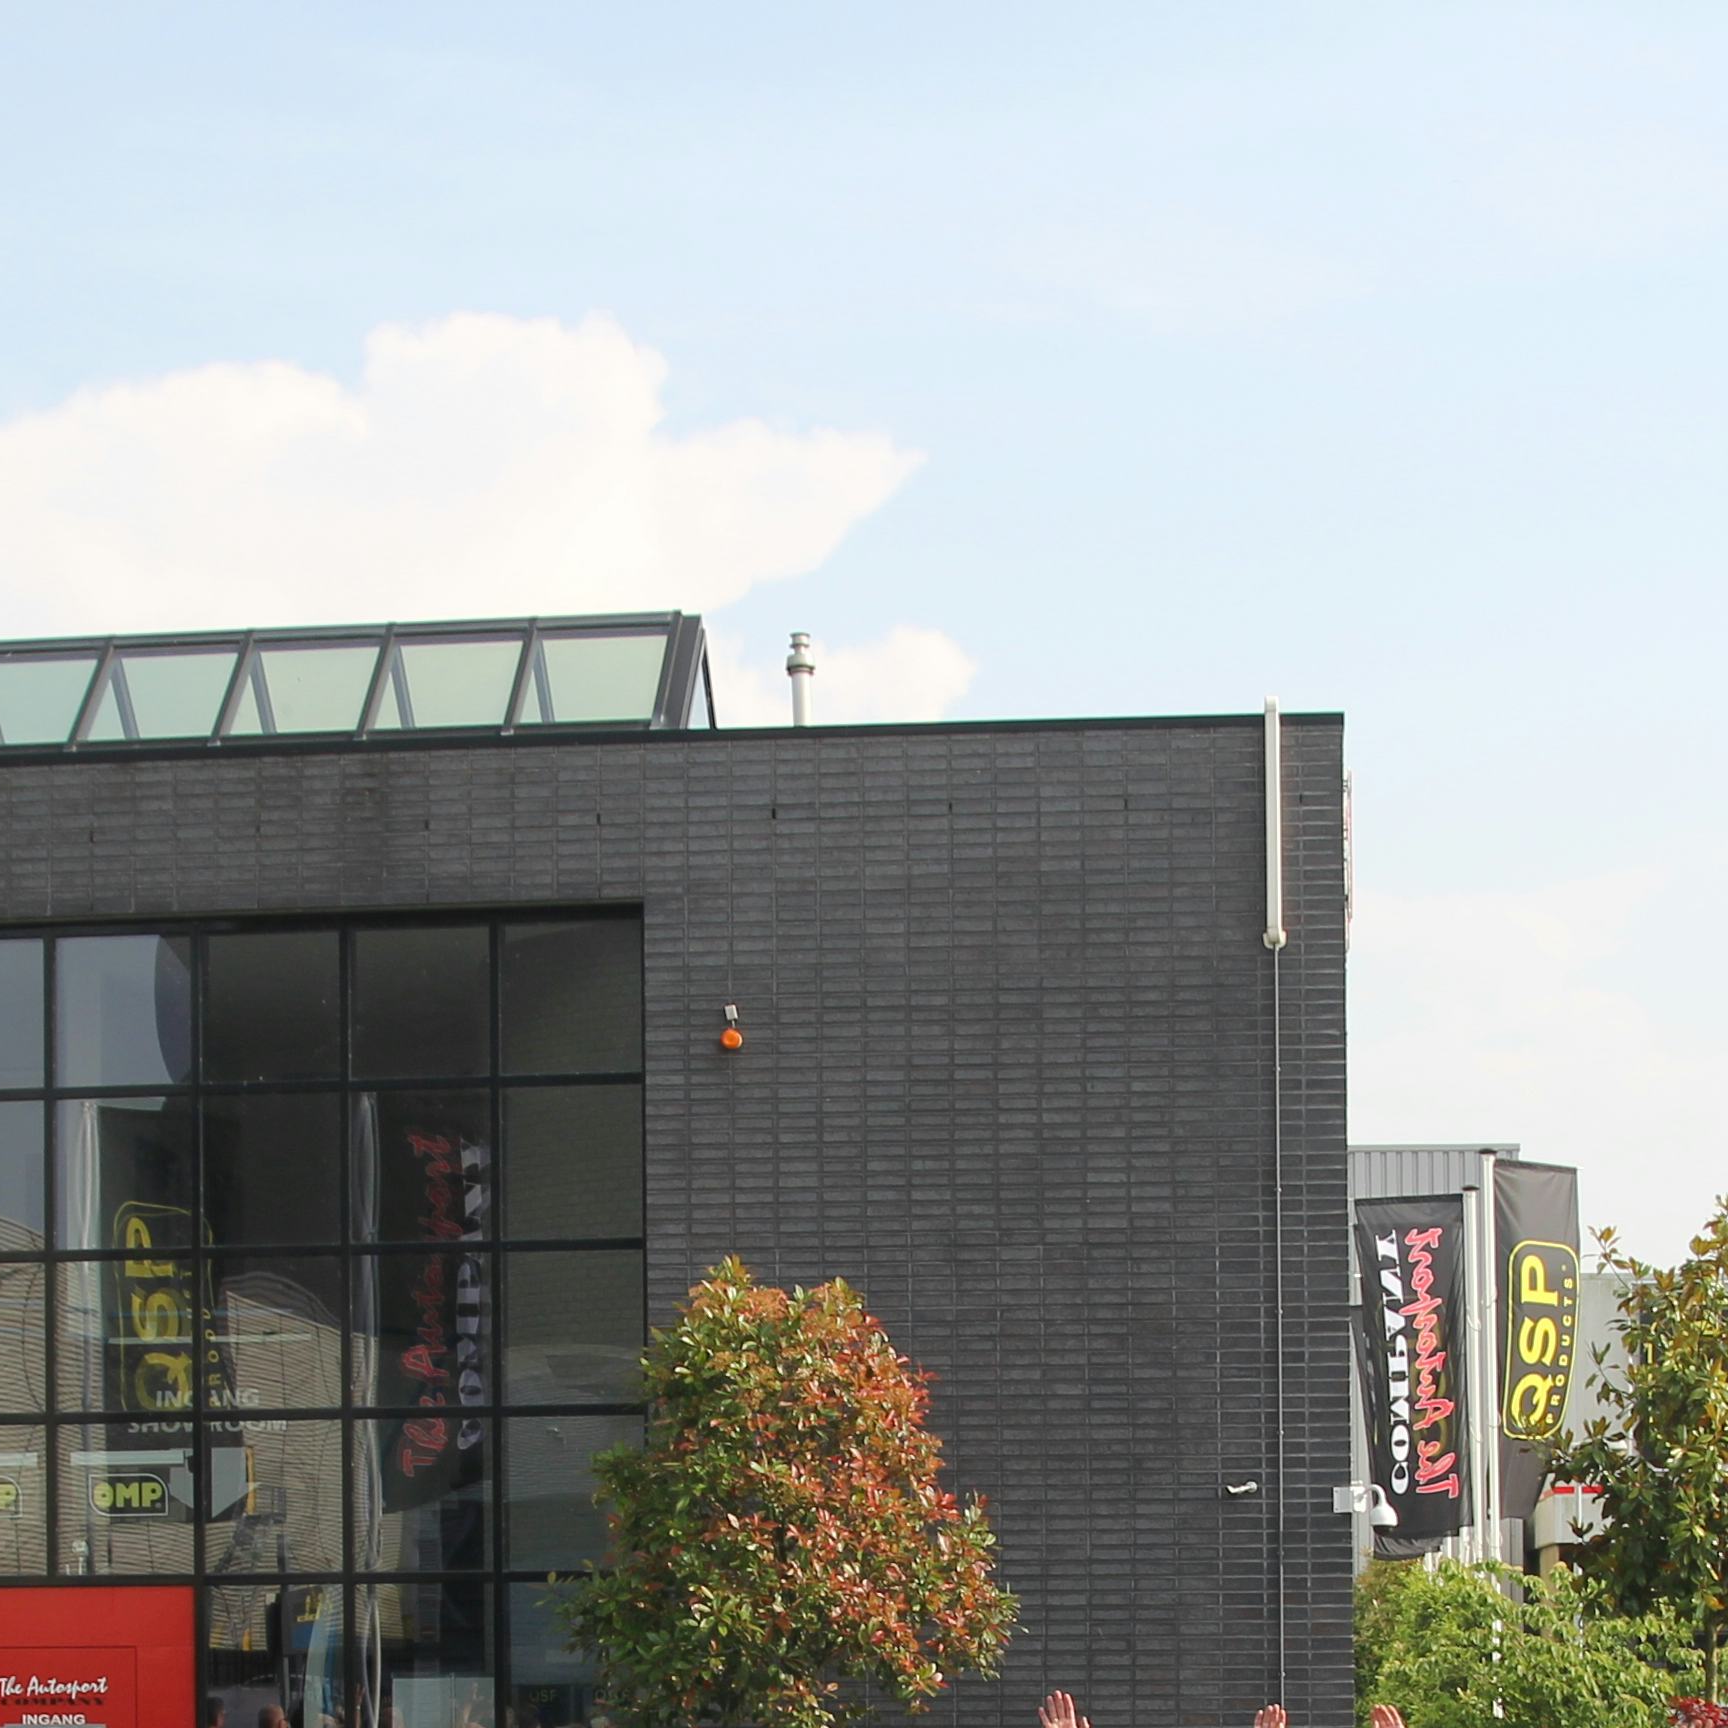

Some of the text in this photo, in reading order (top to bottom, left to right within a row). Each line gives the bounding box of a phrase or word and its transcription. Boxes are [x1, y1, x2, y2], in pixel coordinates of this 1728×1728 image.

[1511, 1254, 1559, 1429] QSP
[1545, 1276, 1575, 1425] PRODUCTS
[92, 1481, 160, 1507] OMP
[26, 1675, 109, 1700] Autosport
[21, 1713, 86, 1725] INGANG
